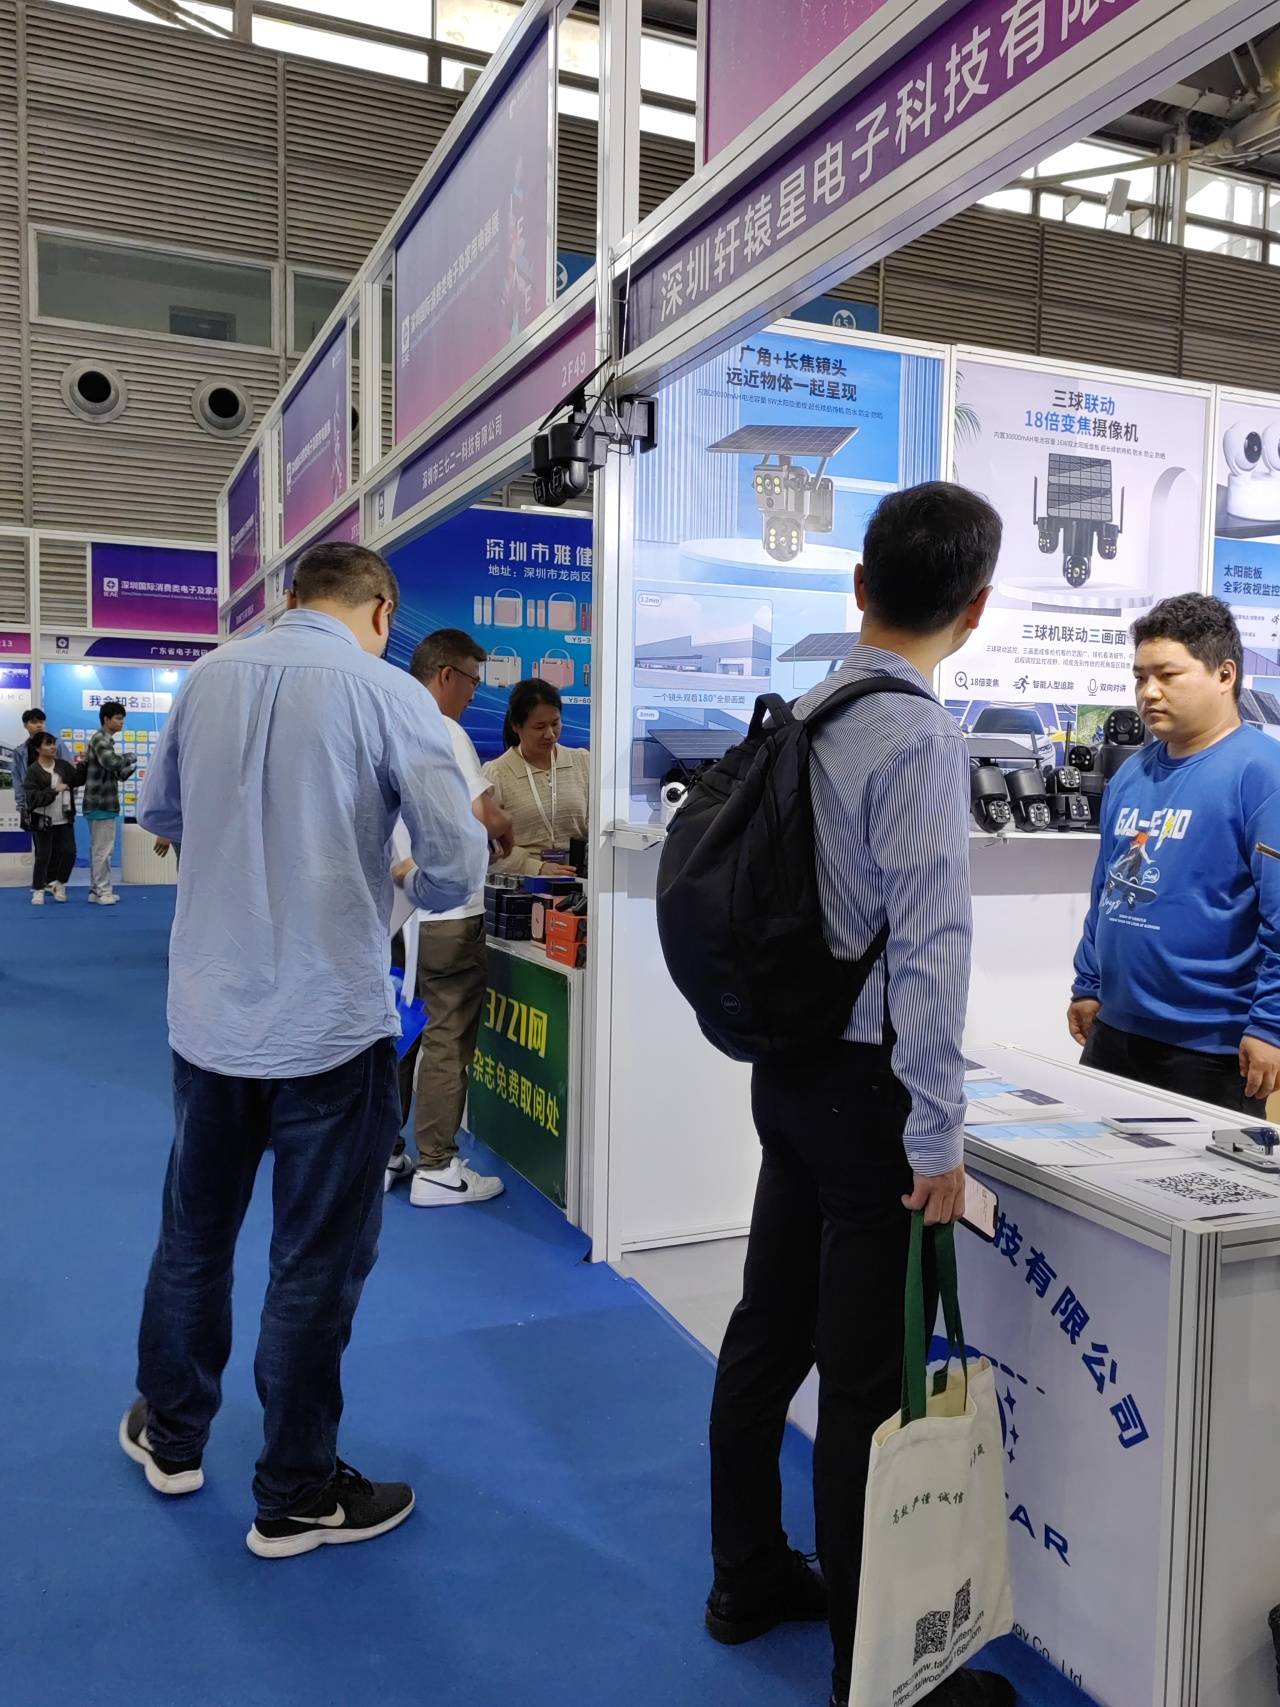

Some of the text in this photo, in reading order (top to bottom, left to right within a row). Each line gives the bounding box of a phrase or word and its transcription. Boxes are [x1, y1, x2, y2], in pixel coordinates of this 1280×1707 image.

[560, 351, 587, 388] 2F49
[739, 345, 847, 377] 广角+长焦镜头
[726, 367, 857, 402] 远近物体一起呈现
[1052, 389, 1116, 416] 三球联动
[1025, 410, 1139, 443] 18倍变焦摄像机
[421, 413, 503, 490] 深圳市三七二一科技有限公司
[486, 538, 592, 567] 深圳市雅健
[488, 564, 592, 582] 地址：深圳市龙岗区
[1223, 564, 1263, 579] 太阳能板
[1223, 580, 1280, 597] 全彩夜视监控
[1021, 624, 1127, 645] 三球机联动三画面
[970, 677, 1127, 693] 18倍变焦 智能人型追踪 双向对讲
[484, 986, 548, 1059] 3721网
[473, 1047, 560, 1138] 杂志免费取阅处
[1005, 1491, 1071, 1568] AR
